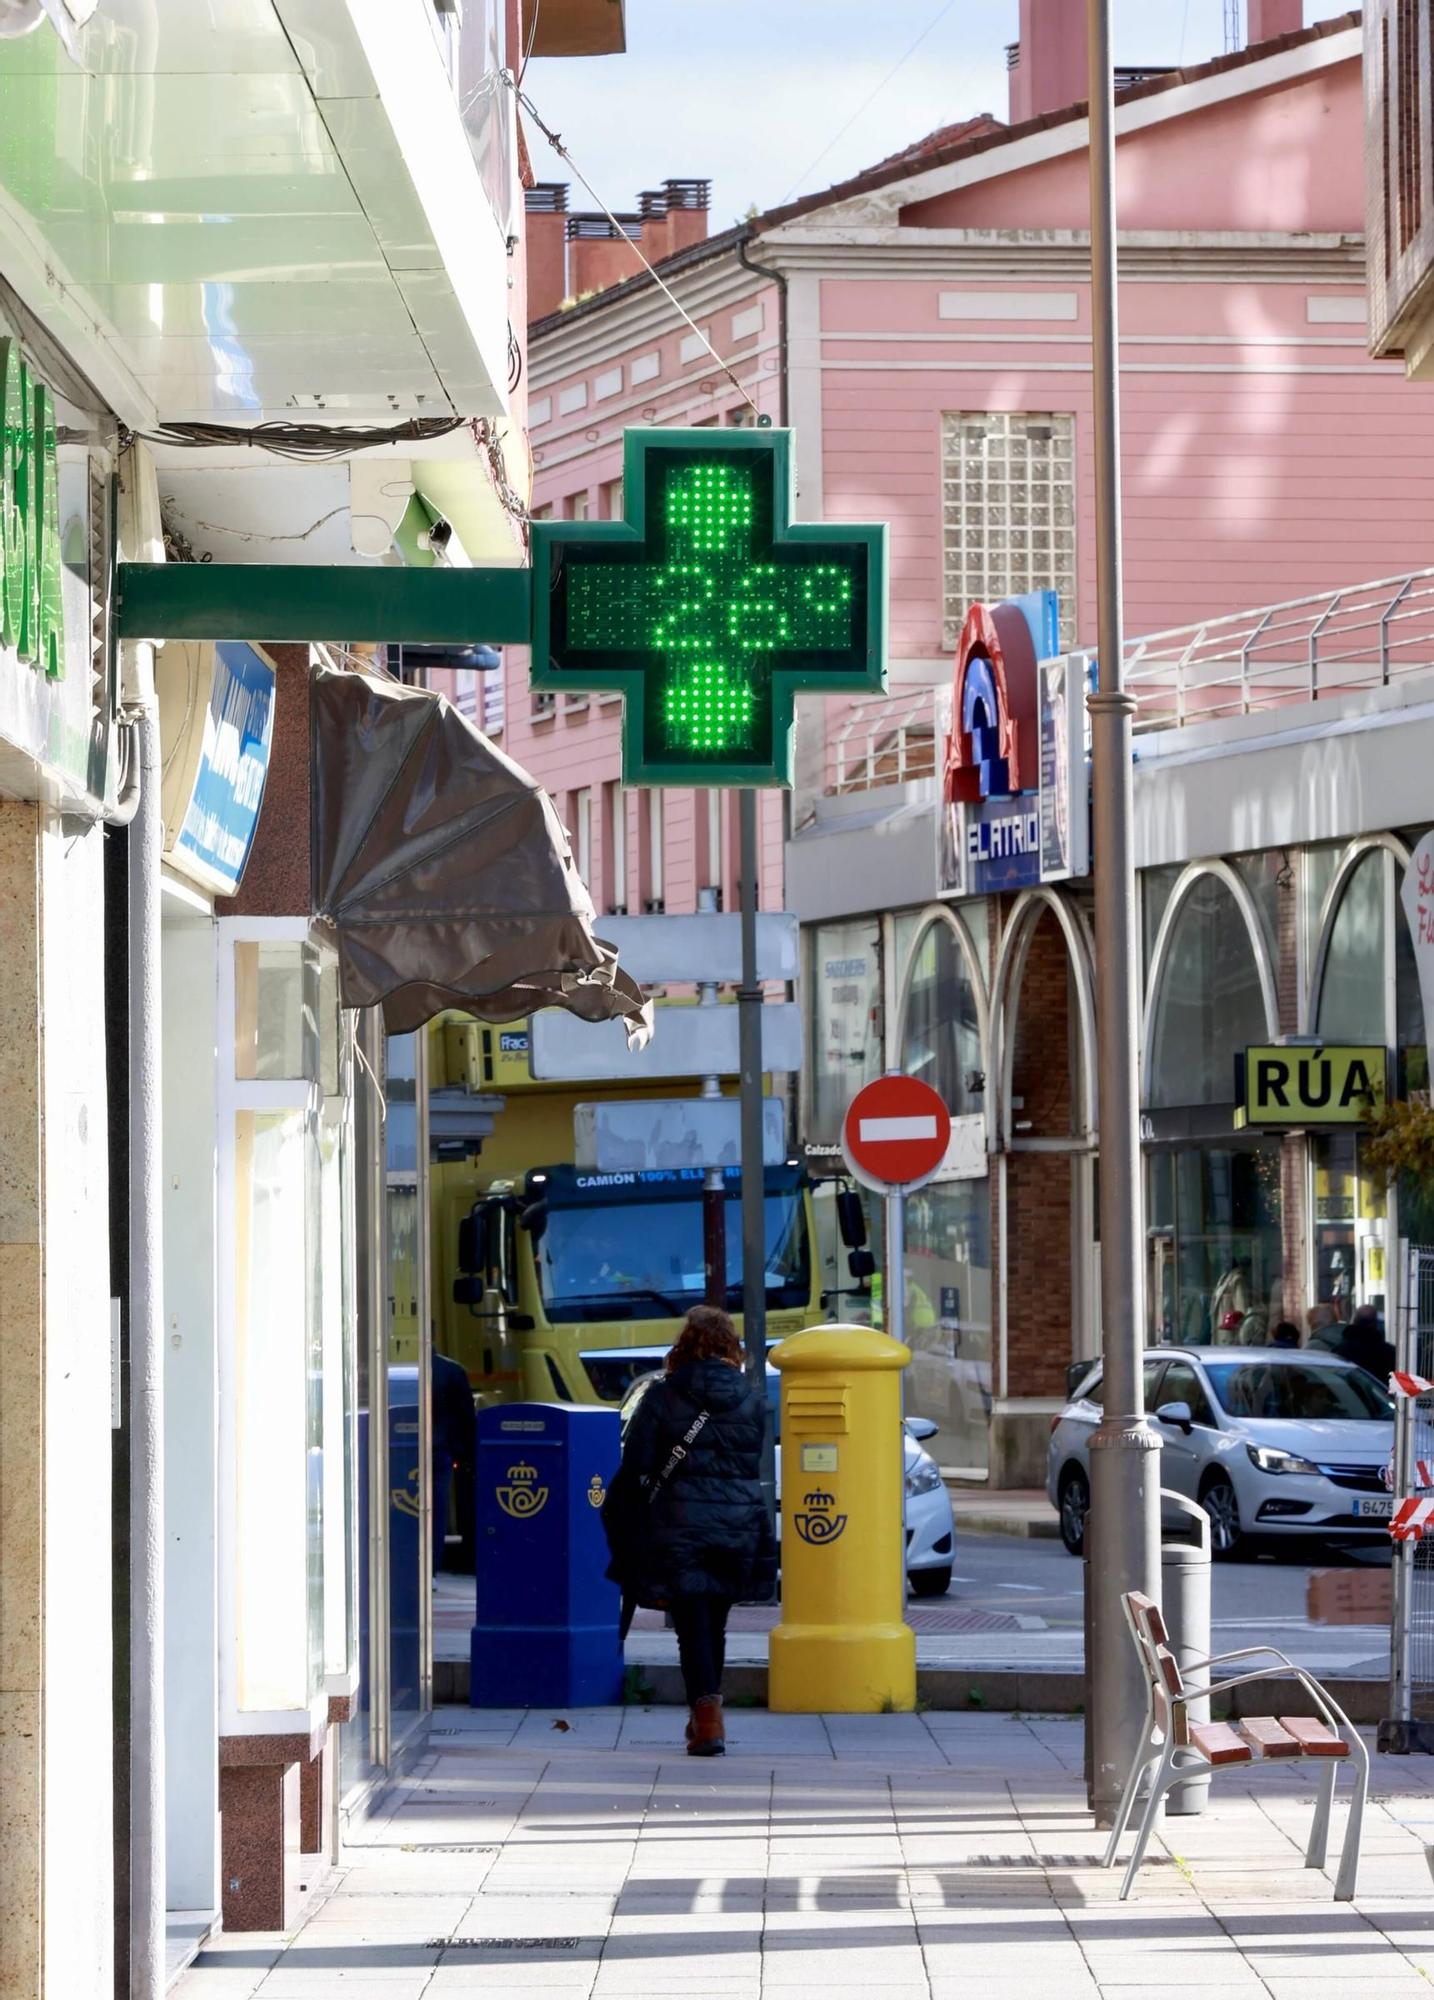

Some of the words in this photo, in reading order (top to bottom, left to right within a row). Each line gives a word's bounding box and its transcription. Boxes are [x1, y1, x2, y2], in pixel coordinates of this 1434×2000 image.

[968, 821, 990, 862] EL
[990, 812, 1039, 859] ATRIO
[1257, 1048, 1377, 1107] RÚA
[576, 1172, 635, 1188] CAMIÓN
